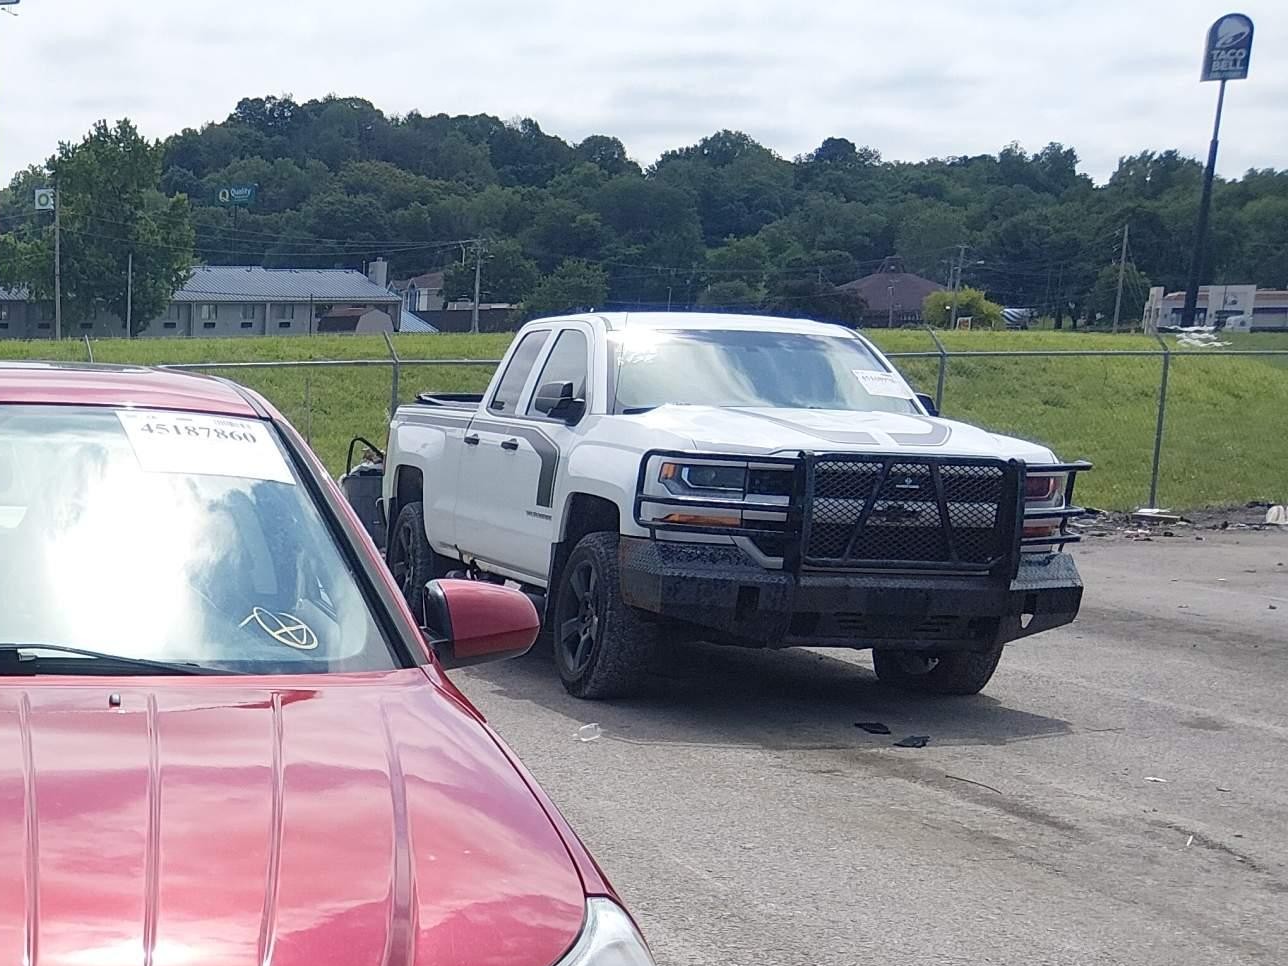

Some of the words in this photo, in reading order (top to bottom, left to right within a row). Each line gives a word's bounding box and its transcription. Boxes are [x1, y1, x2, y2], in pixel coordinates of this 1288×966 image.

[1211, 49, 1246, 60] TACO
[1212, 59, 1243, 71] BELL
[140, 423, 257, 443] 45187860
